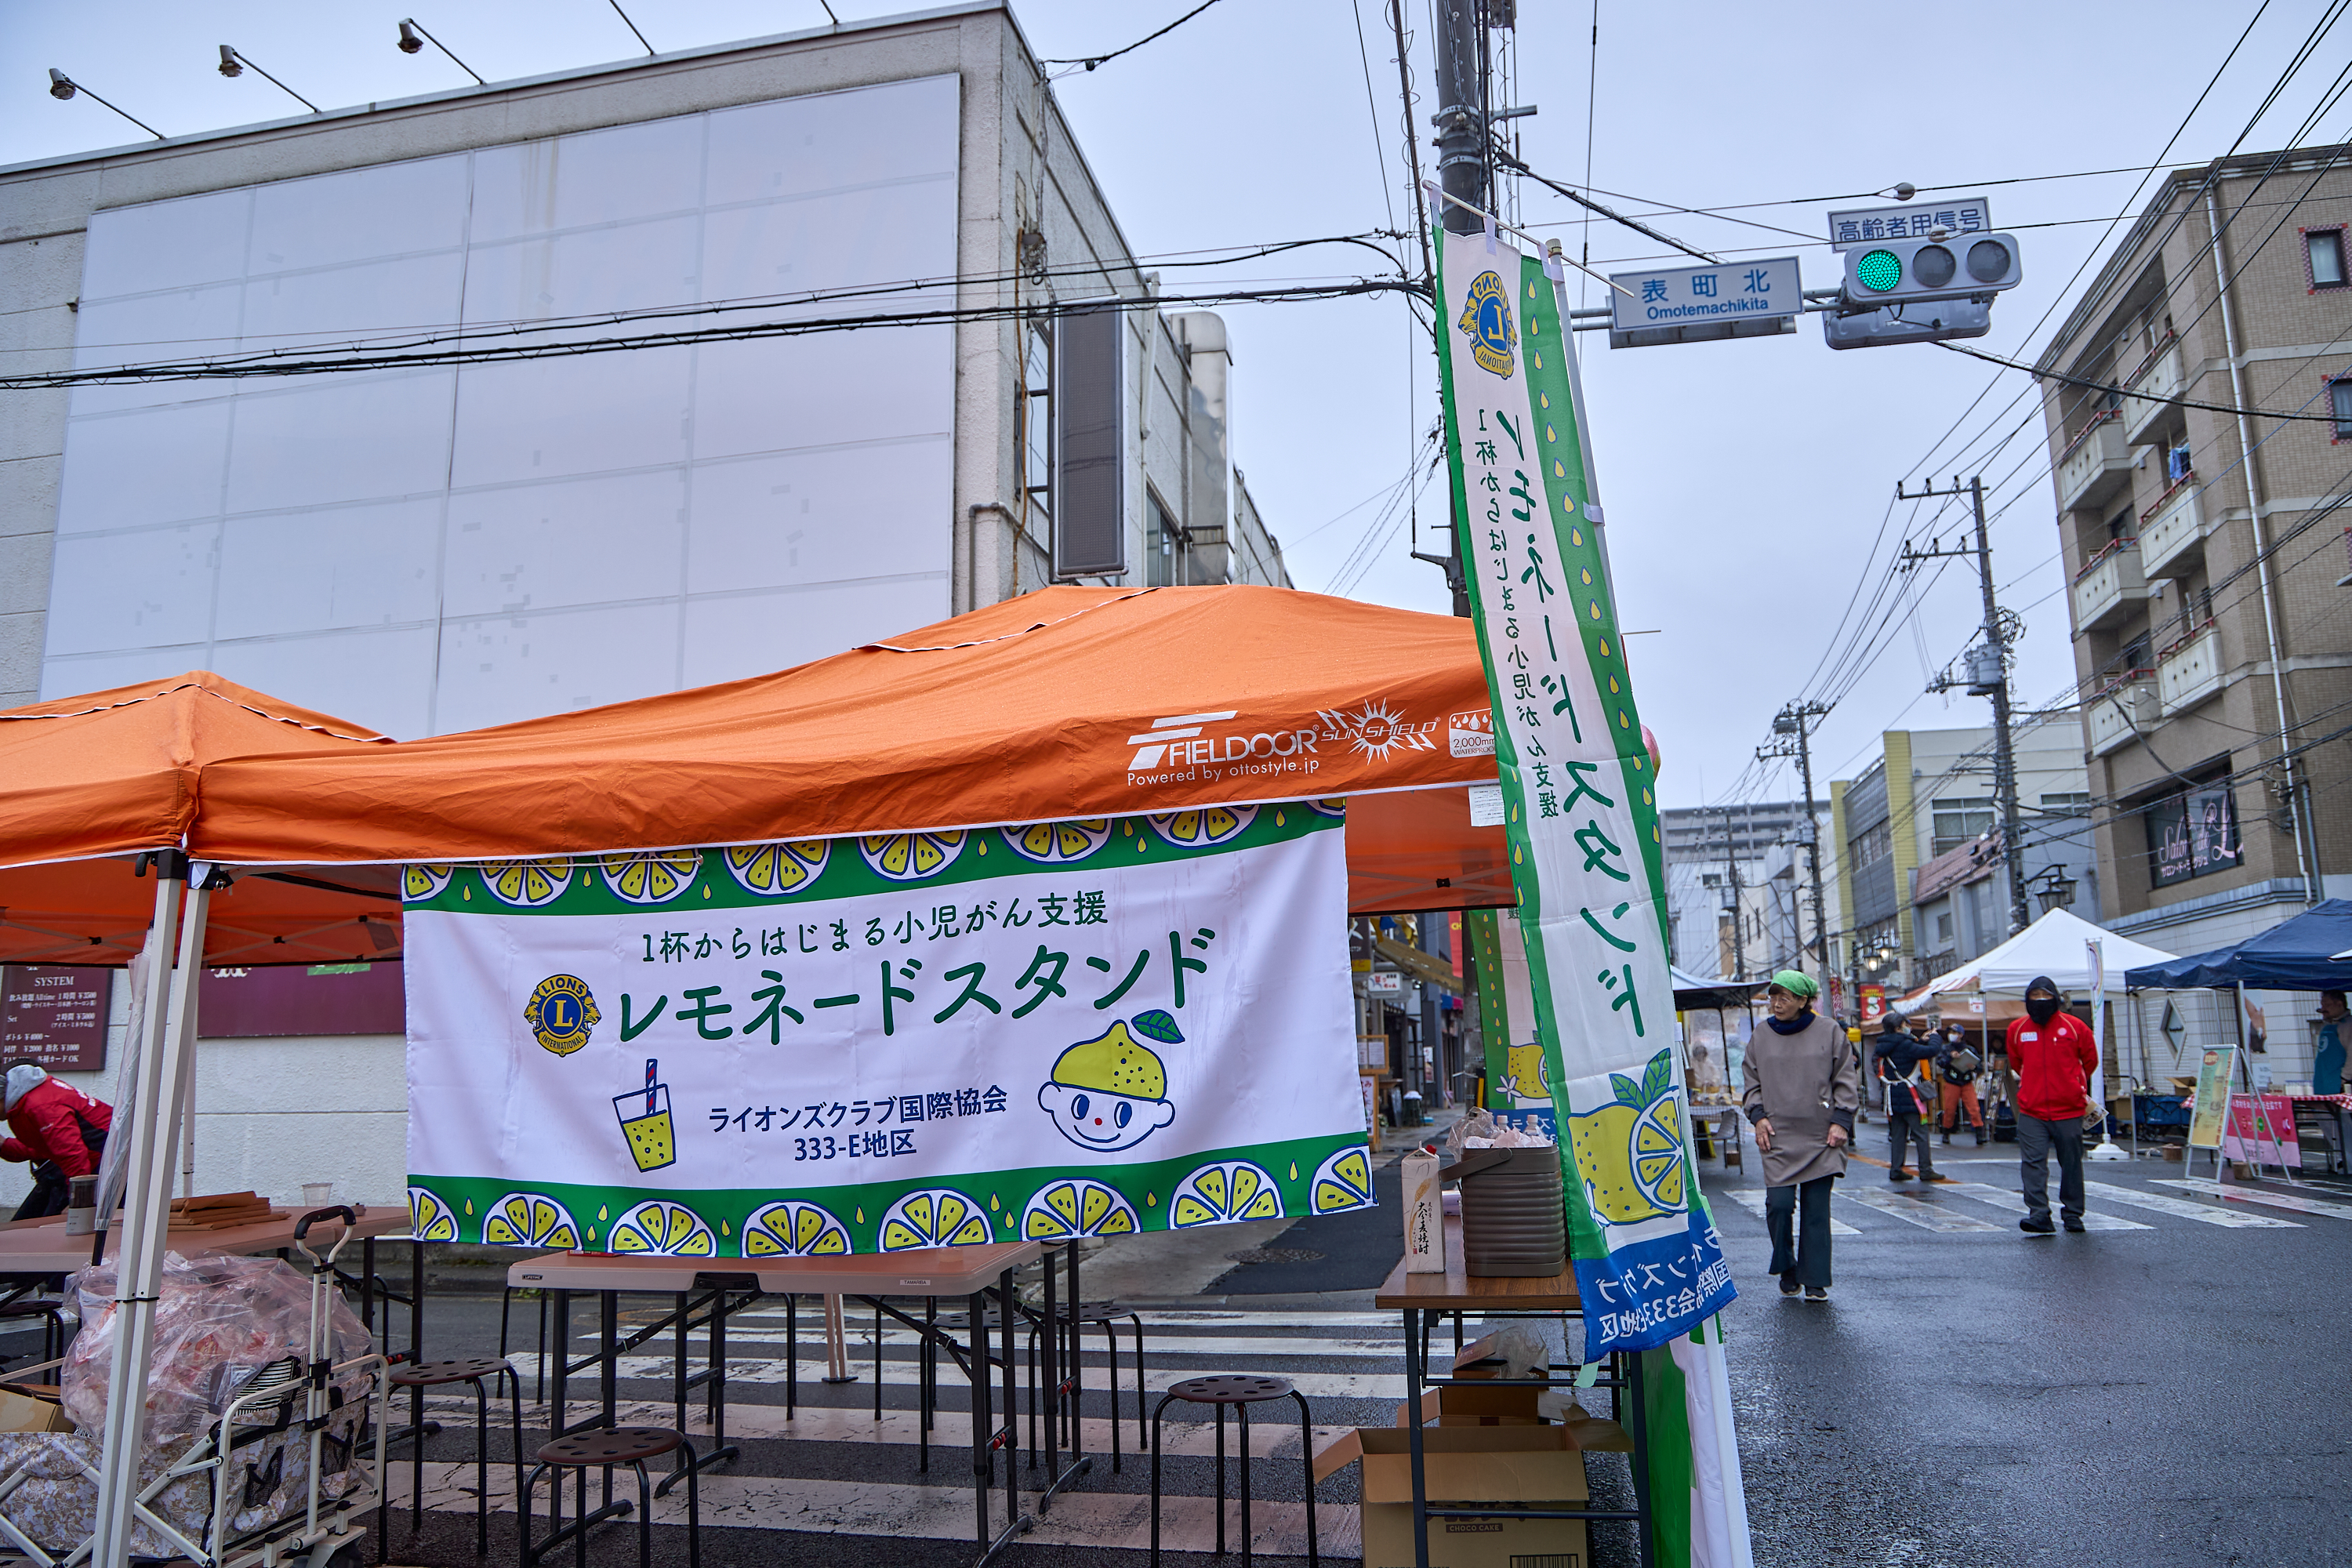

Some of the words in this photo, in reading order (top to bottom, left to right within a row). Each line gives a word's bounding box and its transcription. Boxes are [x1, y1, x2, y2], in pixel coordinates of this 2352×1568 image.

[1837, 208, 1982, 242] 高齢者用信号
[1642, 268, 1770, 303] 表町北
[1647, 297, 1769, 320] Omotemachikita
[1320, 728, 1364, 742] SUN
[1365, 721, 1437, 738] SHIELD
[1169, 730, 1318, 767] FIELDOOR
[1454, 745, 1496, 756] WATERPROO
[1127, 765, 1196, 786] Powered
[1203, 764, 1222, 782] by
[1229, 757, 1319, 777] ottostyle.jp
[642, 889, 1109, 964] 1杯からはじまる小児がん支援
[34, 976, 74, 987] SYSTEM
[541, 977, 585, 995] LIONS
[619, 927, 1216, 1046] レモネードスタンド
[554, 1000, 573, 1027] L
[541, 1034, 584, 1051] INTERNATIONAL
[709, 1084, 1007, 1133] ライオンズクラブ国際協会
[794, 1128, 917, 1162] 333-E地区
